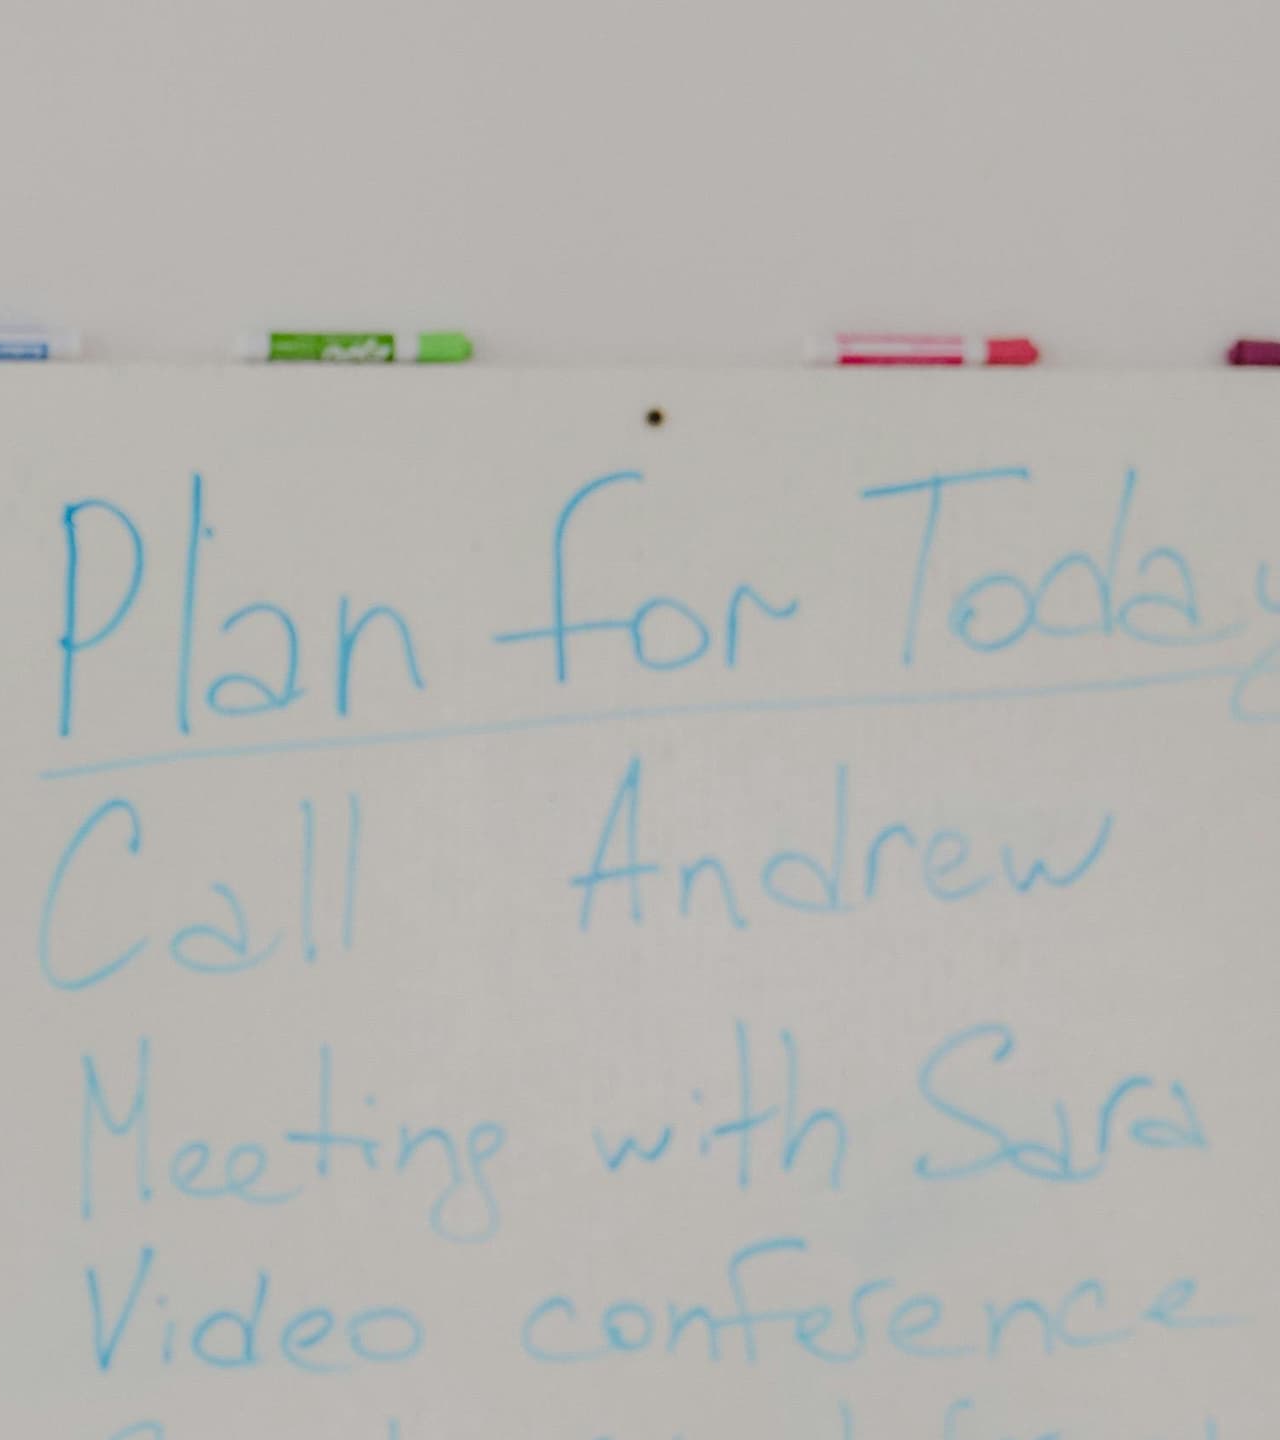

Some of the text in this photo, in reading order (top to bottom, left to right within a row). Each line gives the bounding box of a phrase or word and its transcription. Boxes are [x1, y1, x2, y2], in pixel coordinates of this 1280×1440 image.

[55, 471, 428, 737] Plan
[490, 468, 801, 685] for
[38, 754, 1115, 993] Call Andrew
[80, 1020, 1208, 1244] Meeting with Sara
[83, 1235, 1248, 1375] Video conference
